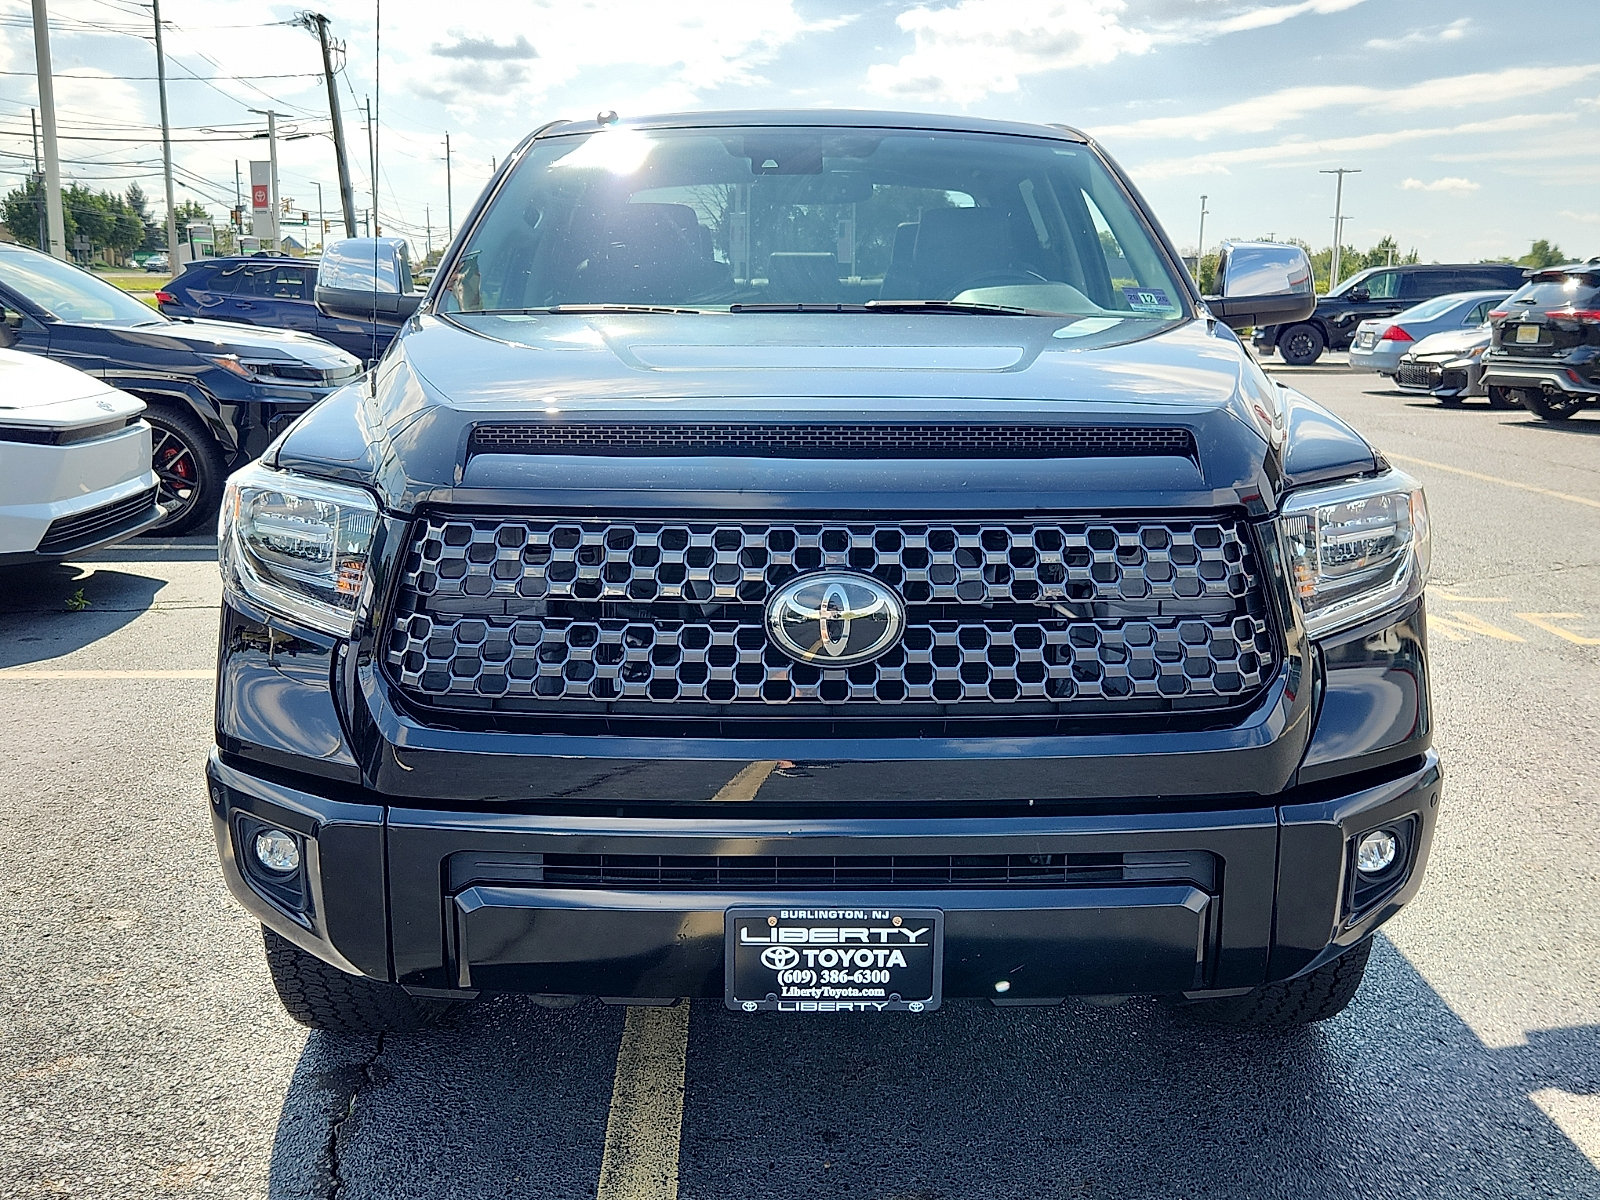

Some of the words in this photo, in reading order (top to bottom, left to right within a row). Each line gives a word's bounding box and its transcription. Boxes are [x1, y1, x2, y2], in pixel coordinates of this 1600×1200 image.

[1140, 294, 1156, 304] 12
[780, 910, 868, 920] BURLINGTON,
[871, 910, 890, 919] NJ
[740, 927, 929, 943] LIBERTY
[802, 949, 907, 967] TOYOTA
[777, 969, 818, 987] (609)
[819, 969, 891, 984] 386-6300
[780, 986, 886, 999] LibertyToyota.com
[777, 1001, 889, 1012] LIBERTY
